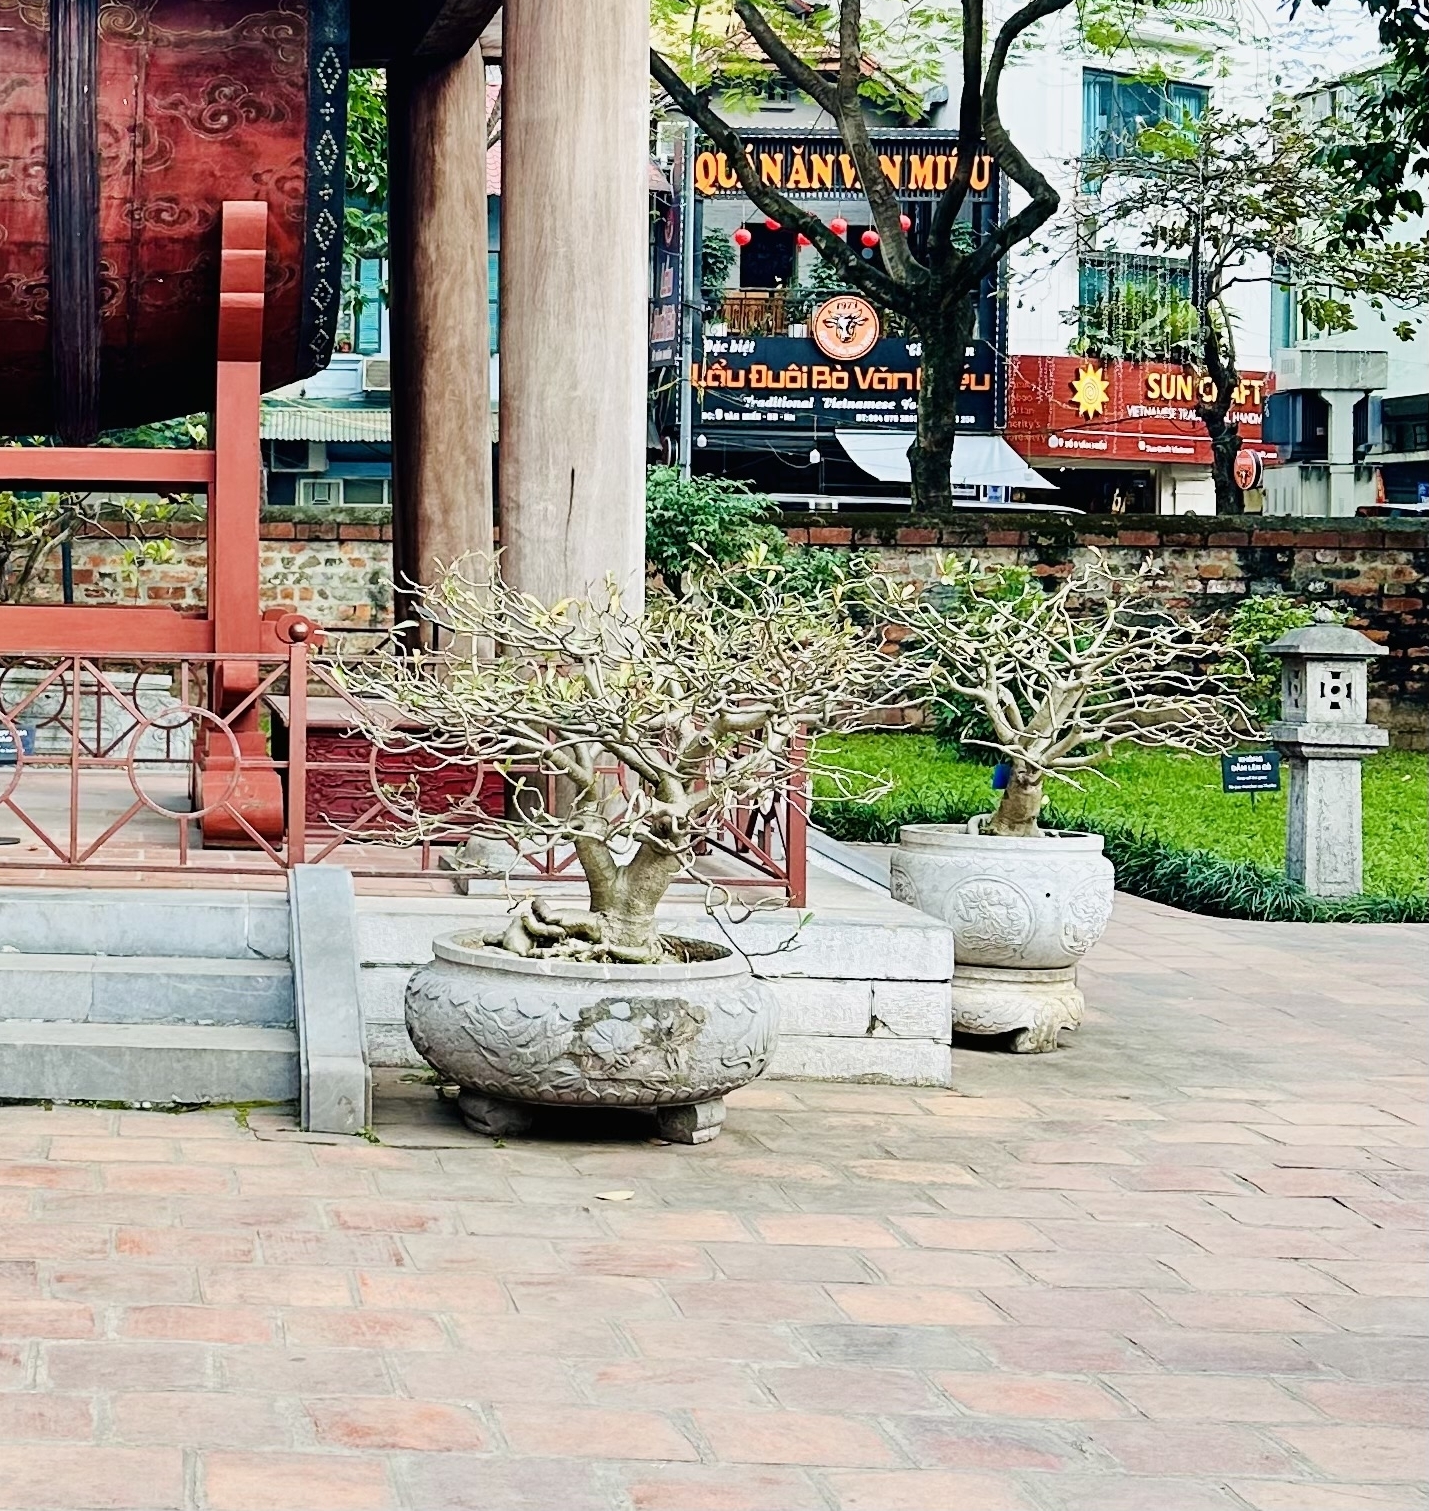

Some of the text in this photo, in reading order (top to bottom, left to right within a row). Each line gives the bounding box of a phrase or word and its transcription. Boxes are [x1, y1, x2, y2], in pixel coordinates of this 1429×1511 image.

[786, 145, 835, 190] ĂN
[838, 153, 903, 190] VN
[749, 363, 808, 389] Đuôi
[812, 364, 849, 389] Bò
[854, 366, 913, 390] Văn
[1147, 372, 1264, 405] SUN CAFT
[742, 394, 815, 409] Traditional
[821, 396, 897, 410] Vietnamese
